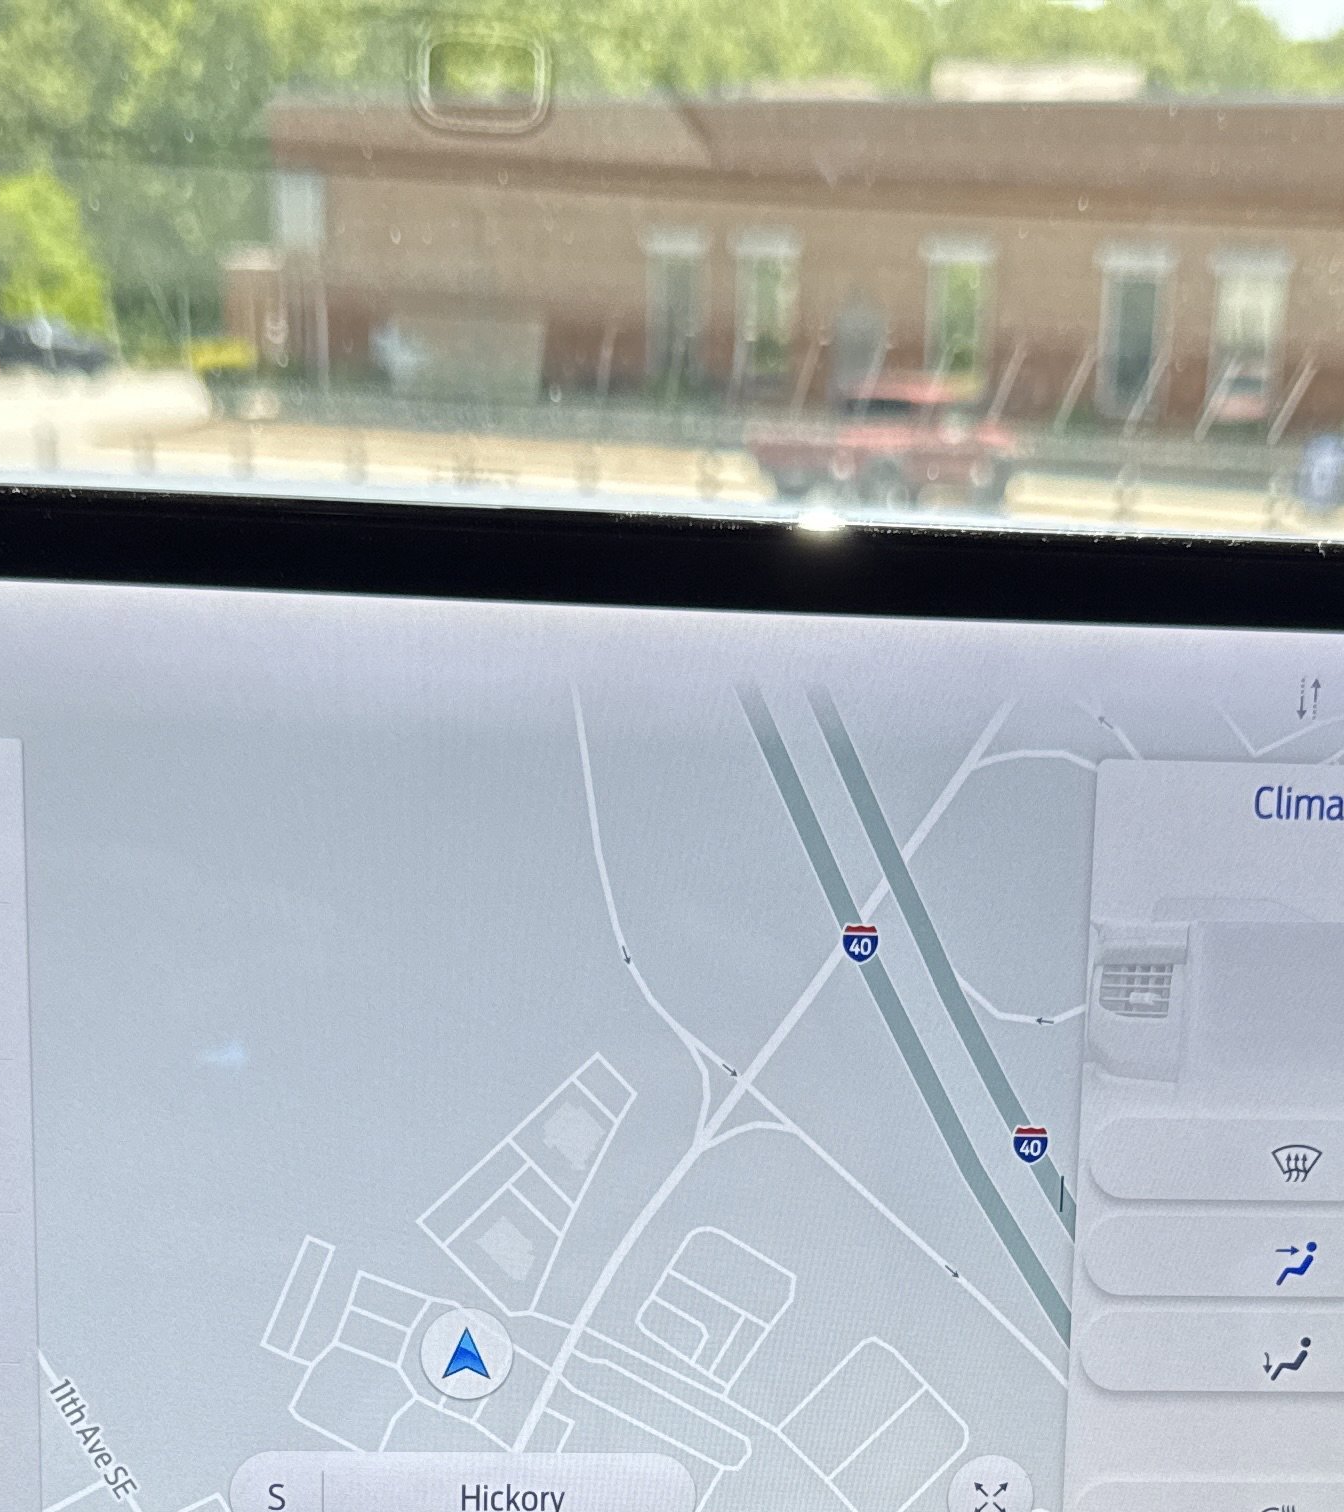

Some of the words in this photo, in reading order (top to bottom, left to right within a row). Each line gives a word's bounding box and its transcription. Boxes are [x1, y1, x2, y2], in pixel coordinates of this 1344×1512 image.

[849, 937, 872, 956] 40
[1019, 1138, 1042, 1157] 40
[49, 1378, 89, 1426] 11th
[75, 1425, 114, 1470] Ave
[103, 1465, 138, 1500] SE
[267, 1483, 287, 1511] S
